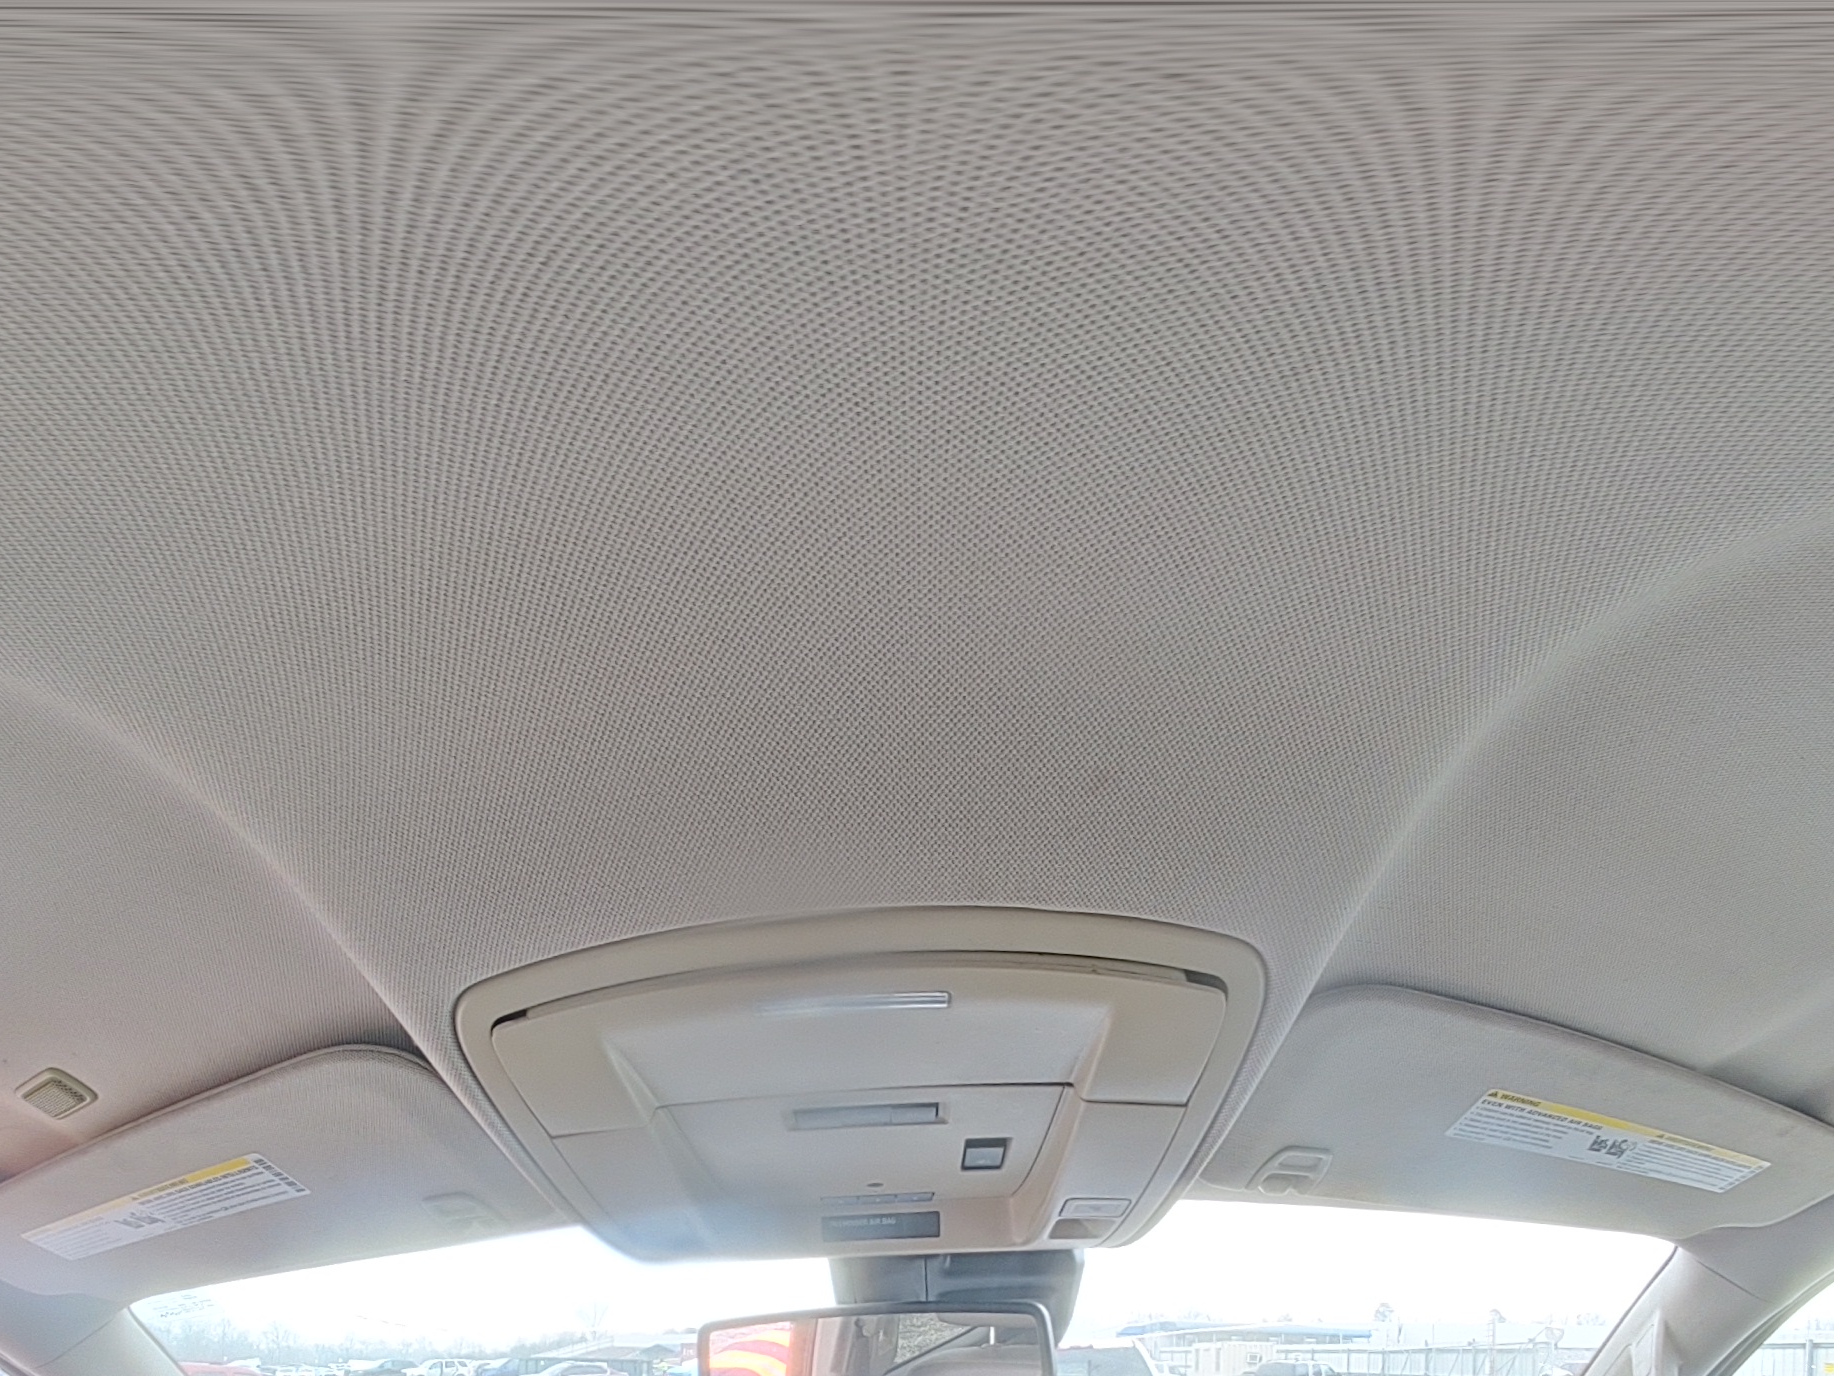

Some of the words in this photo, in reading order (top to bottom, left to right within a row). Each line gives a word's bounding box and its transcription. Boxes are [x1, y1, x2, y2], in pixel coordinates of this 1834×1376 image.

[1500, 1093, 1541, 1108] WARNING
[1481, 1099, 1502, 1108] EVEN
[1505, 1104, 1526, 1113] WITH
[1528, 1109, 1566, 1122] ADVANCED
[1567, 1117, 1582, 1126] AIR
[881, 1216, 897, 1225] BAG
